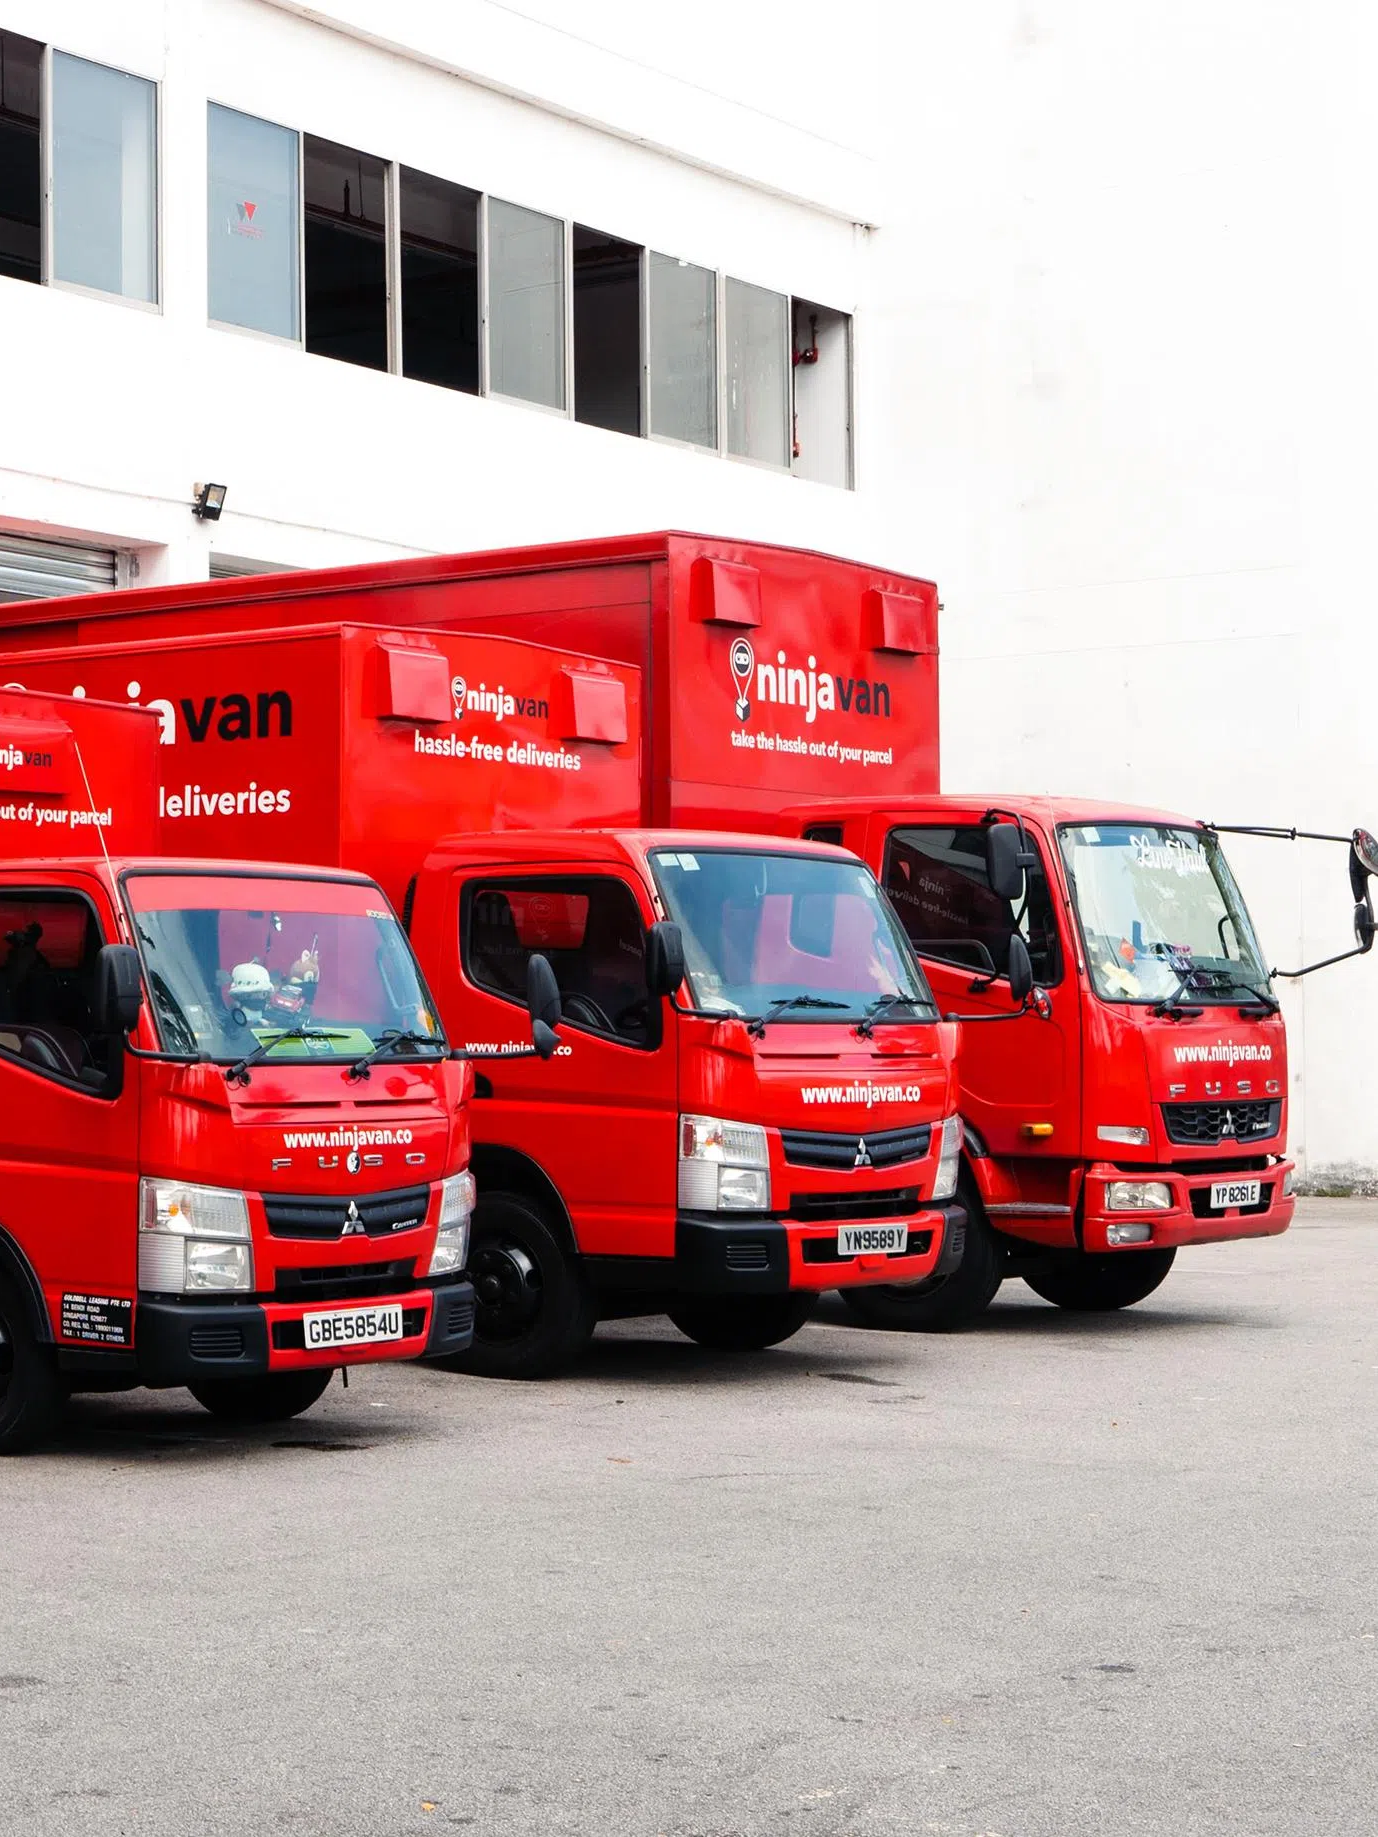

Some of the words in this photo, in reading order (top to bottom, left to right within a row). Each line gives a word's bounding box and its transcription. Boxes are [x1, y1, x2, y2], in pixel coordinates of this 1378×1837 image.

[757, 650, 890, 723] ninjavan
[467, 683, 549, 721] ninjavan
[414, 729, 503, 762] hassle-free
[506, 740, 581, 771] deliveries
[731, 729, 755, 749] take
[757, 731, 774, 750] the
[776, 733, 808, 755] hassle
[809, 741, 826, 757] out
[828, 740, 839, 758] of
[839, 746, 863, 764] your
[863, 748, 893, 767] parcel
[159, 781, 291, 818] eliveries
[18, 802, 34, 821] of
[35, 806, 68, 827] your
[70, 808, 112, 829] parcel
[1173, 1040, 1272, 1068] www.ninjavan.co
[801, 1080, 921, 1109] www.ninjavan.co
[1169, 1080, 1279, 1098] FUSO
[283, 1125, 412, 1151] www.ninjavan.co
[271, 1152, 426, 1172] FUSO
[86, 1305, 100, 1313] ROAD
[88, 1296, 109, 1305] LEASING
[110, 1299, 120, 1307] PTE
[121, 1300, 131, 1308] LTD
[62, 1311, 89, 1321] SINGAPORE
[309, 1312, 399, 1343] GBE5854U
[81, 1331, 99, 1340] DRIVER
[105, 1334, 125, 1343] OTHERS
